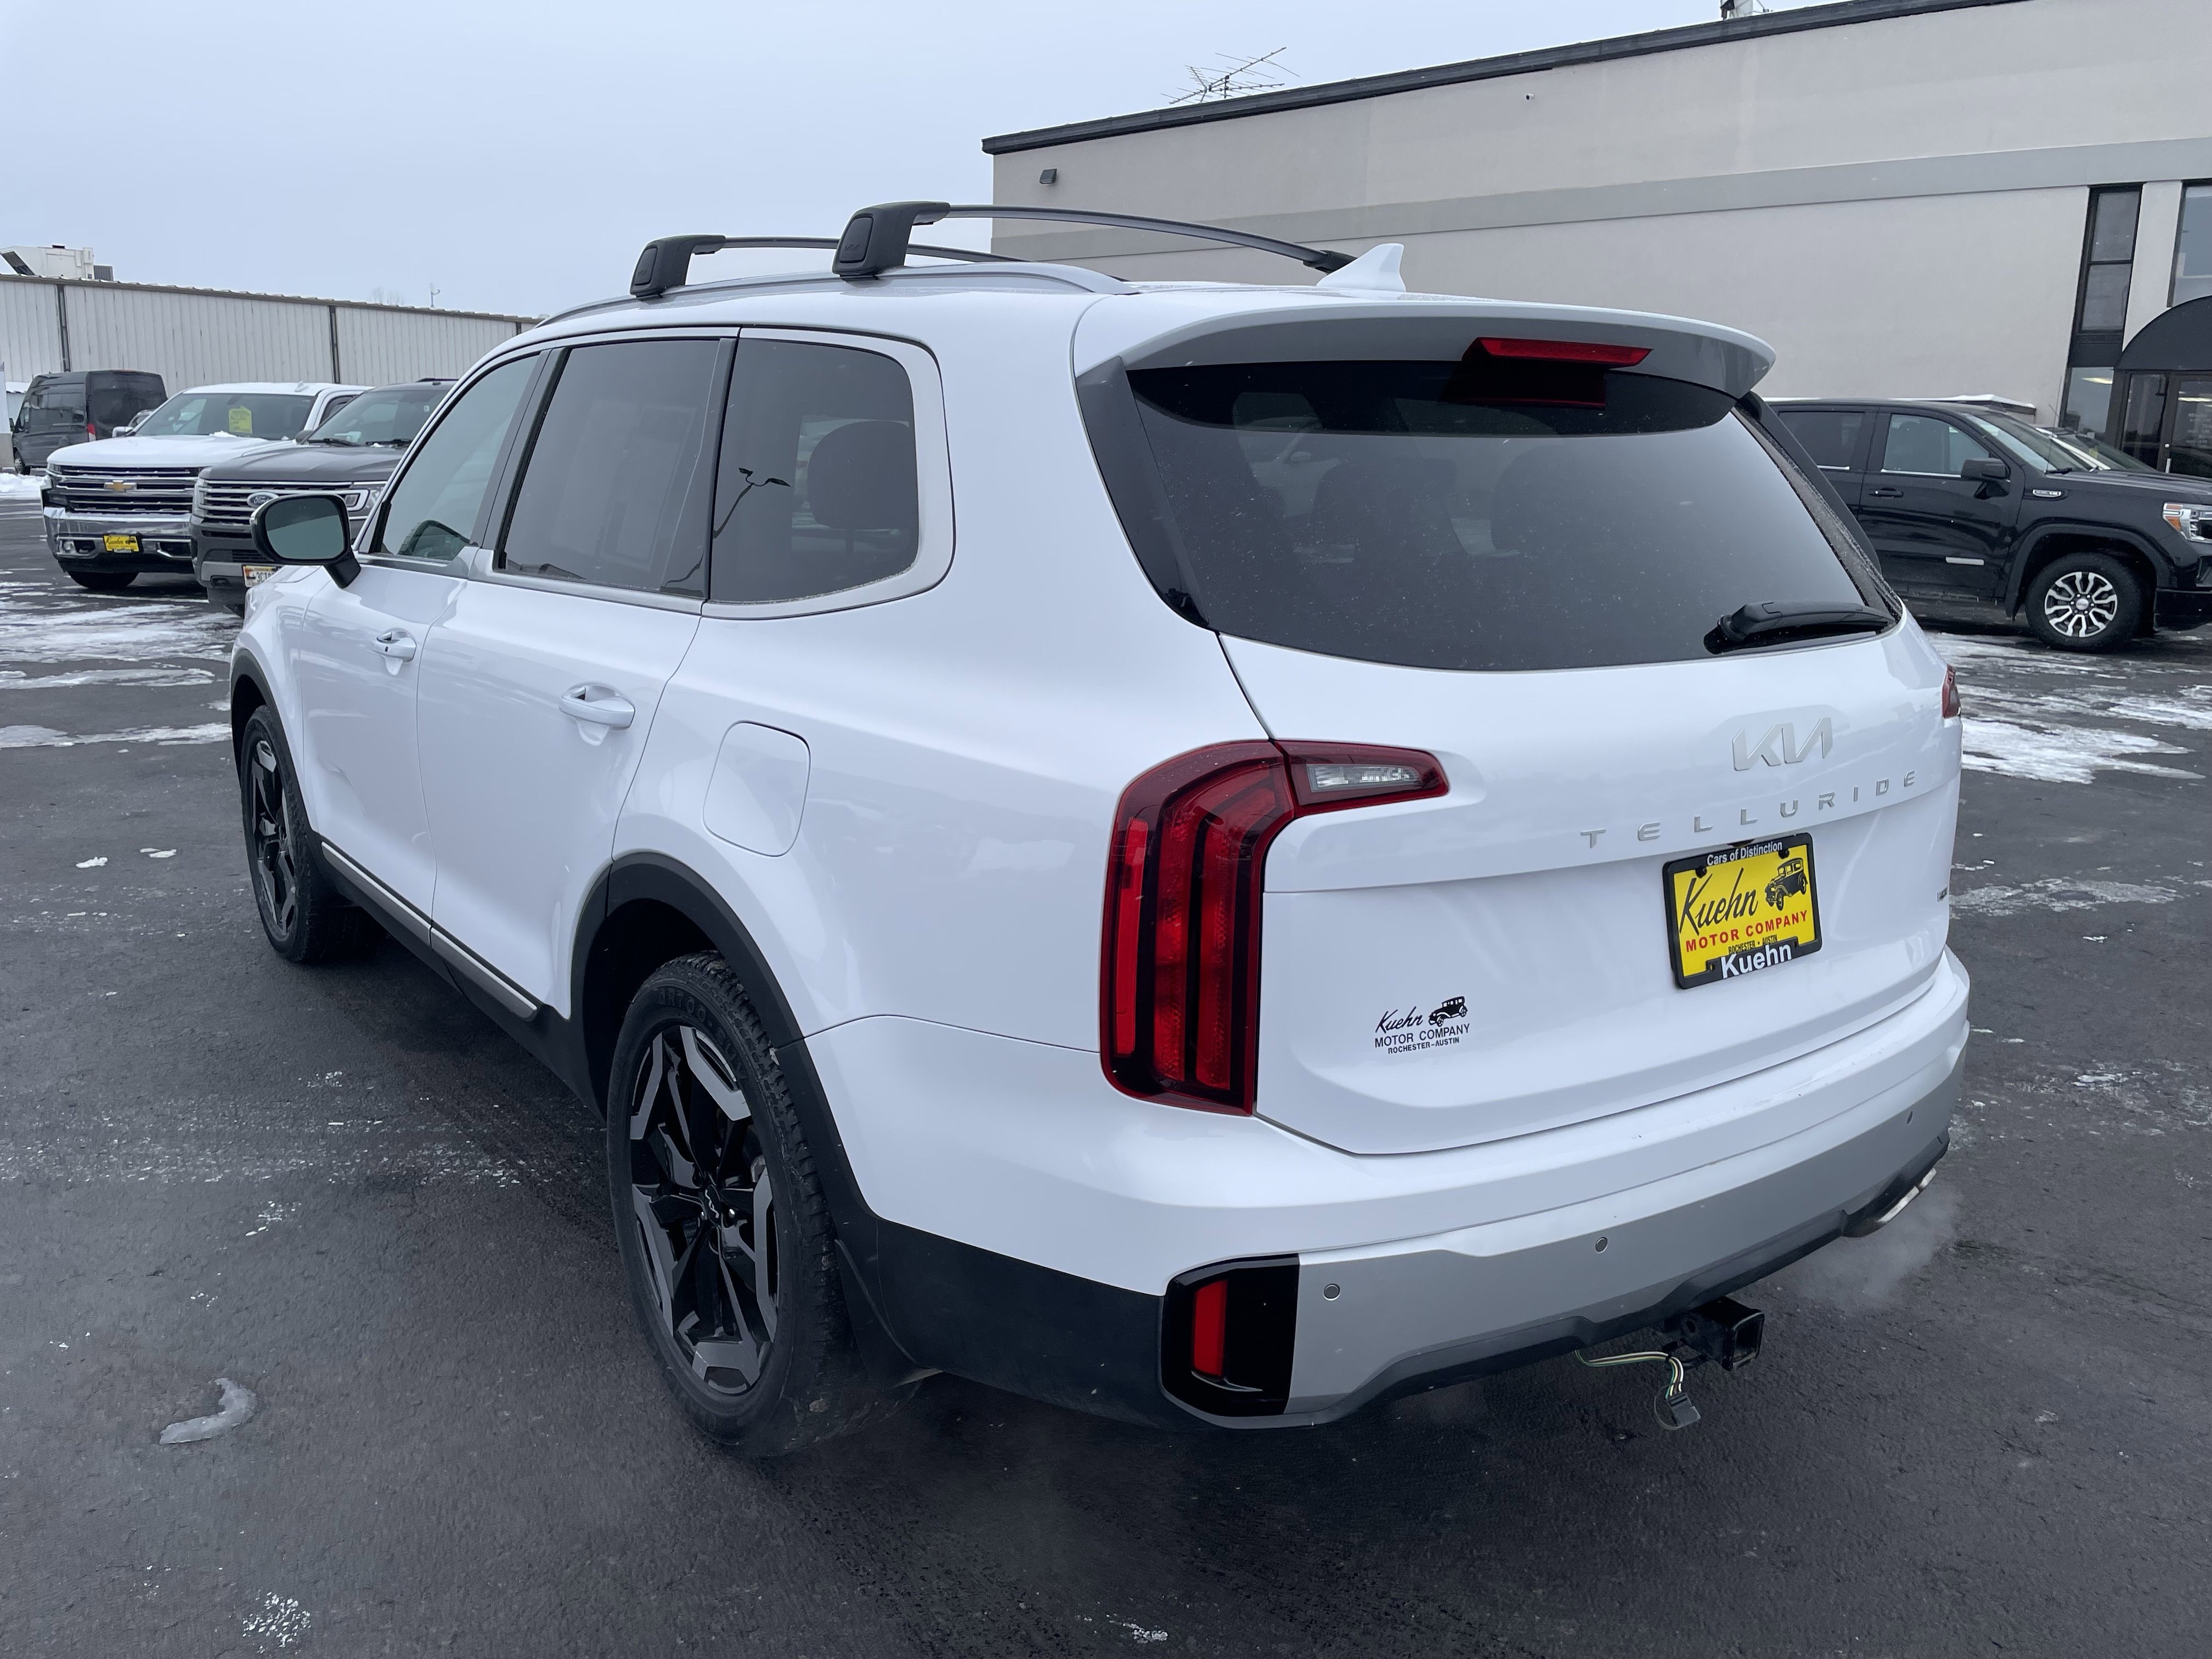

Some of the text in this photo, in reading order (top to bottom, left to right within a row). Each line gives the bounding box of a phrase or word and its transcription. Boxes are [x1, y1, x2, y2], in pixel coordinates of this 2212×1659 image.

[1732, 717, 1833, 771] KIA
[1581, 770, 1915, 849] TELLURIDE
[1707, 840, 1783, 866] Cars of Distinction
[1679, 867, 1759, 936] Kuehn
[1686, 910, 1808, 953] MOTOR COMPANY
[1728, 934, 1778, 954] ROCHESTER AUSTIN
[1720, 944, 1792, 979] Kuehn
[1375, 1006, 1423, 1034] Kuehn
[1375, 1023, 1470, 1048] MOTOR COMPANY
